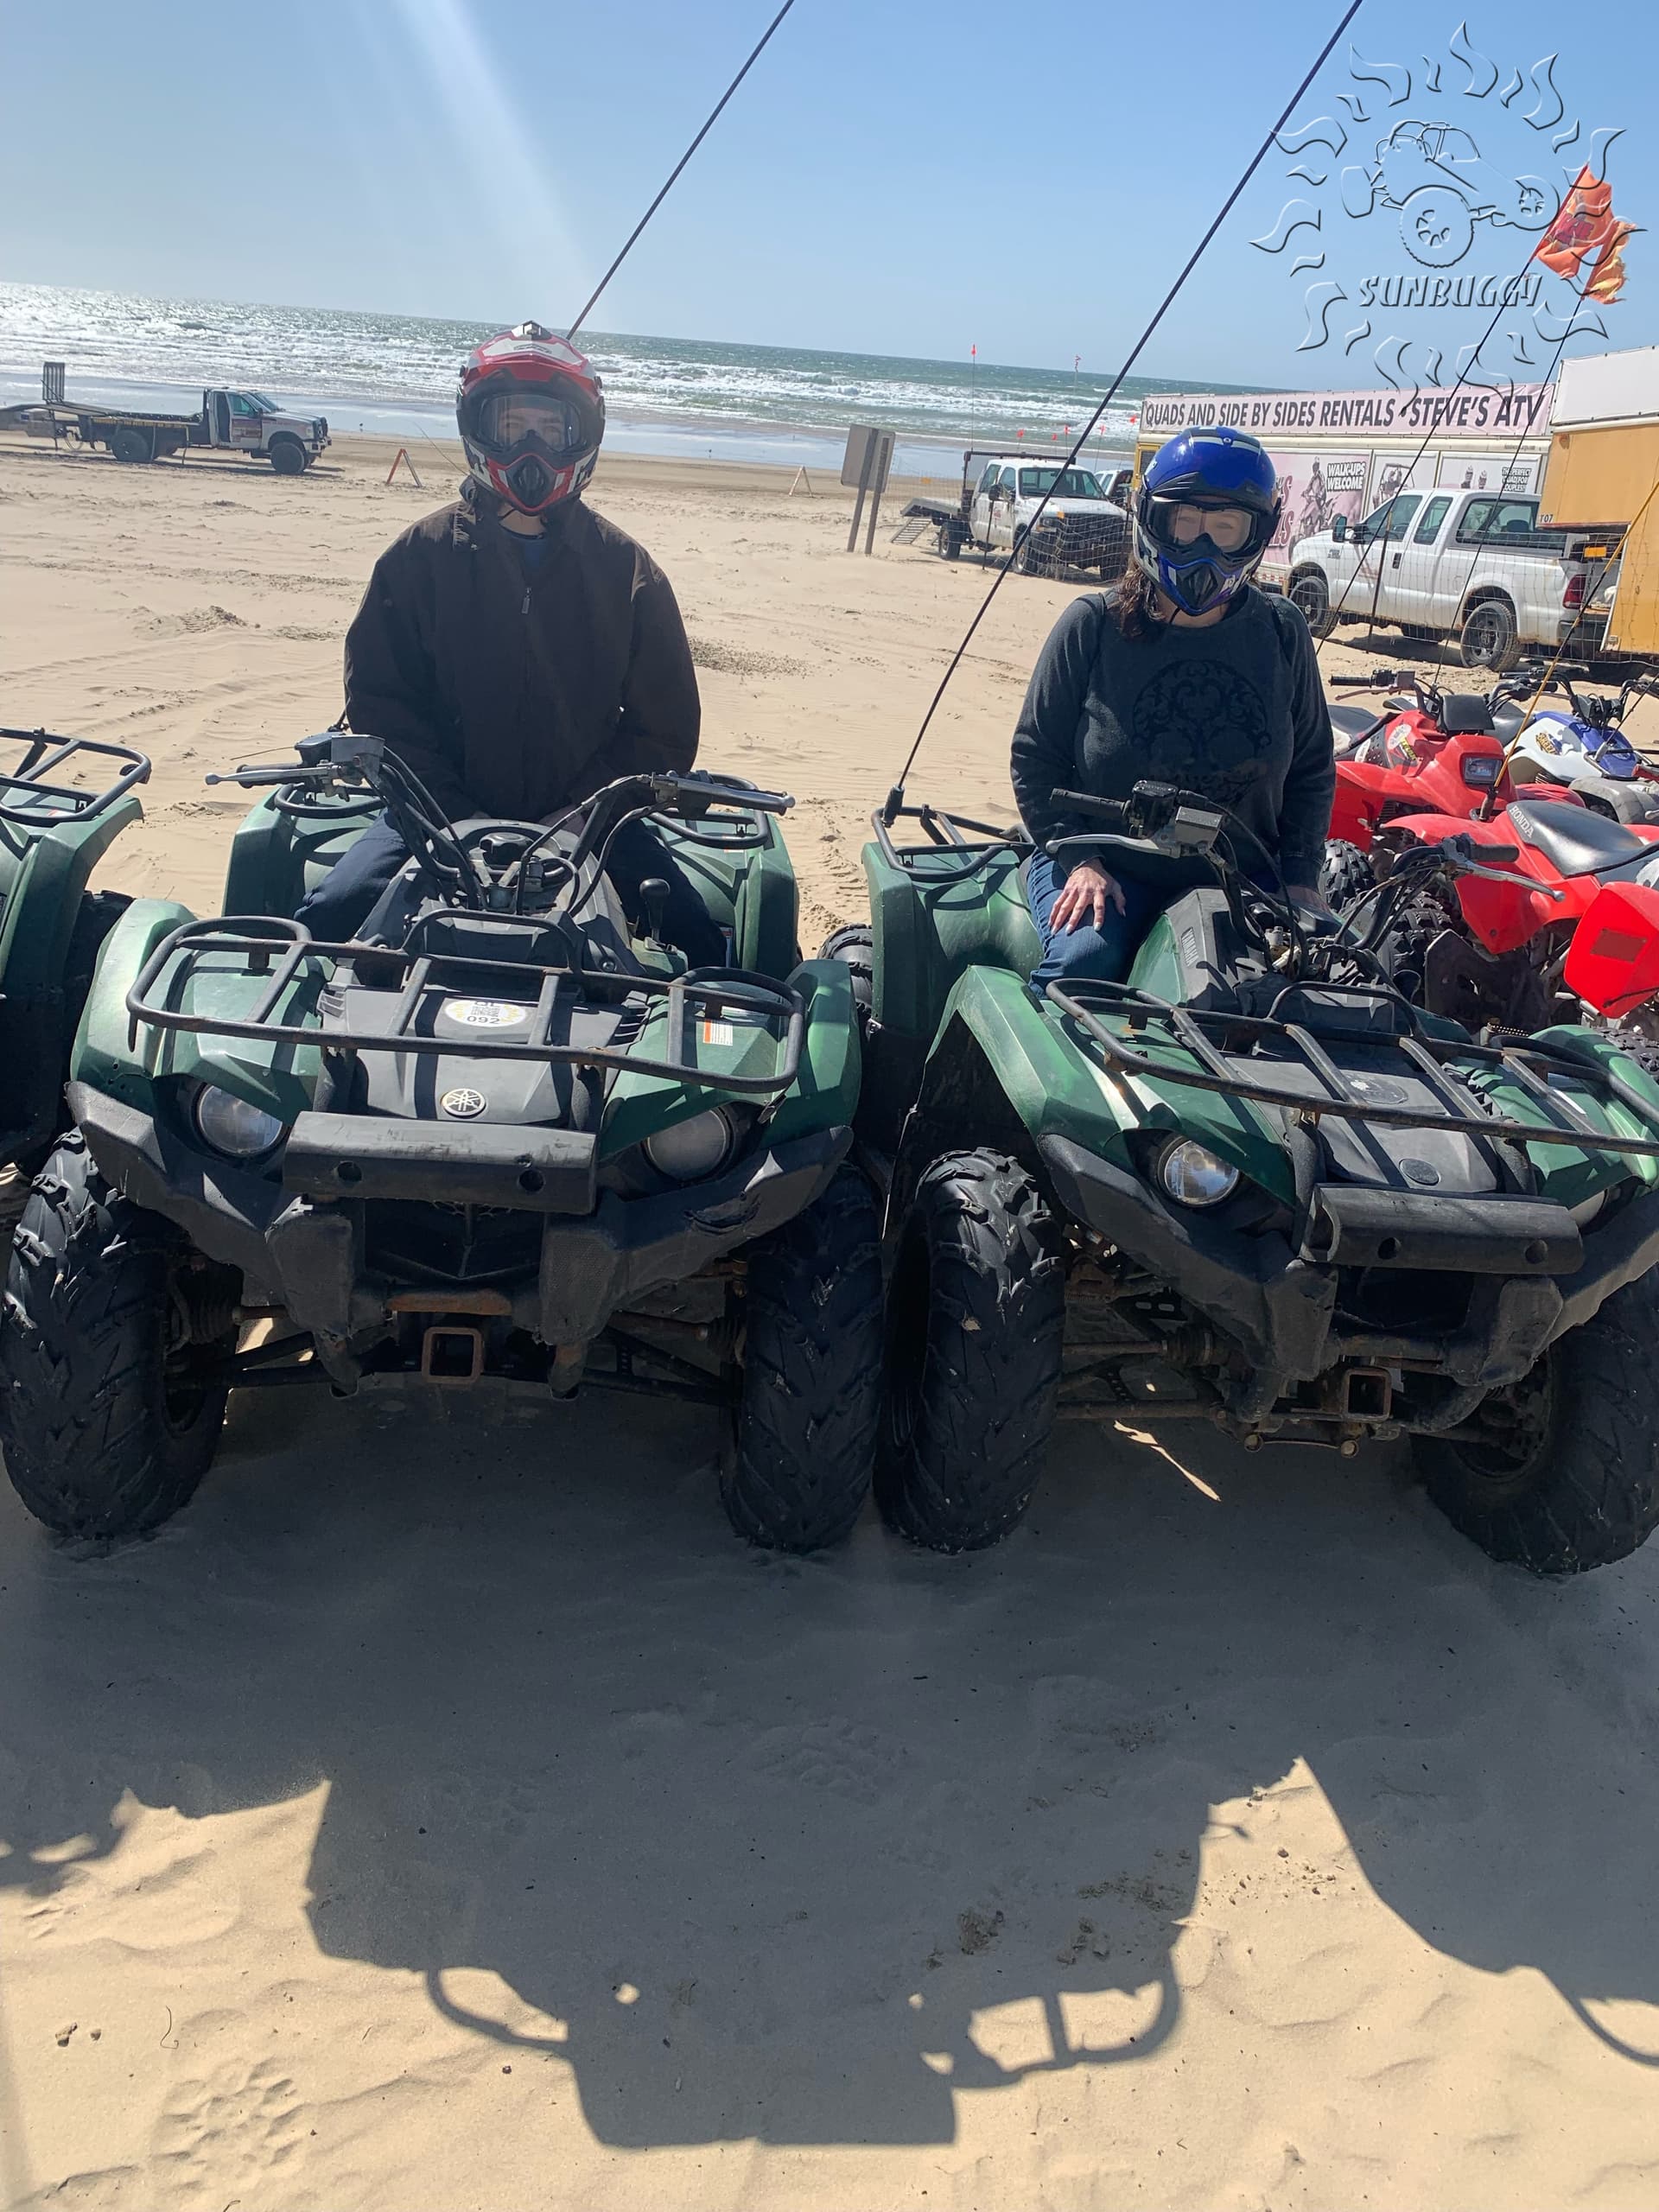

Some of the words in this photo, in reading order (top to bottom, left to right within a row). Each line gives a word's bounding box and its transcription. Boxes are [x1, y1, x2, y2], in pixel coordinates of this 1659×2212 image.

[1146, 402, 1185, 427] QUADS
[1187, 402, 1216, 426] AND
[1218, 402, 1249, 427] SIDE
[1251, 402, 1272, 427] BY
[1273, 400, 1316, 427] SIDES
[1319, 397, 1395, 427] RENTALS
[1408, 396, 1491, 428] STEVE'S
[1493, 394, 1545, 427] ATV
[1327, 462, 1366, 477] WALK-UPS
[1327, 476, 1363, 491] WELCOME
[1509, 804, 1535, 838] HONDA
[467, 1015, 500, 1024] 092
